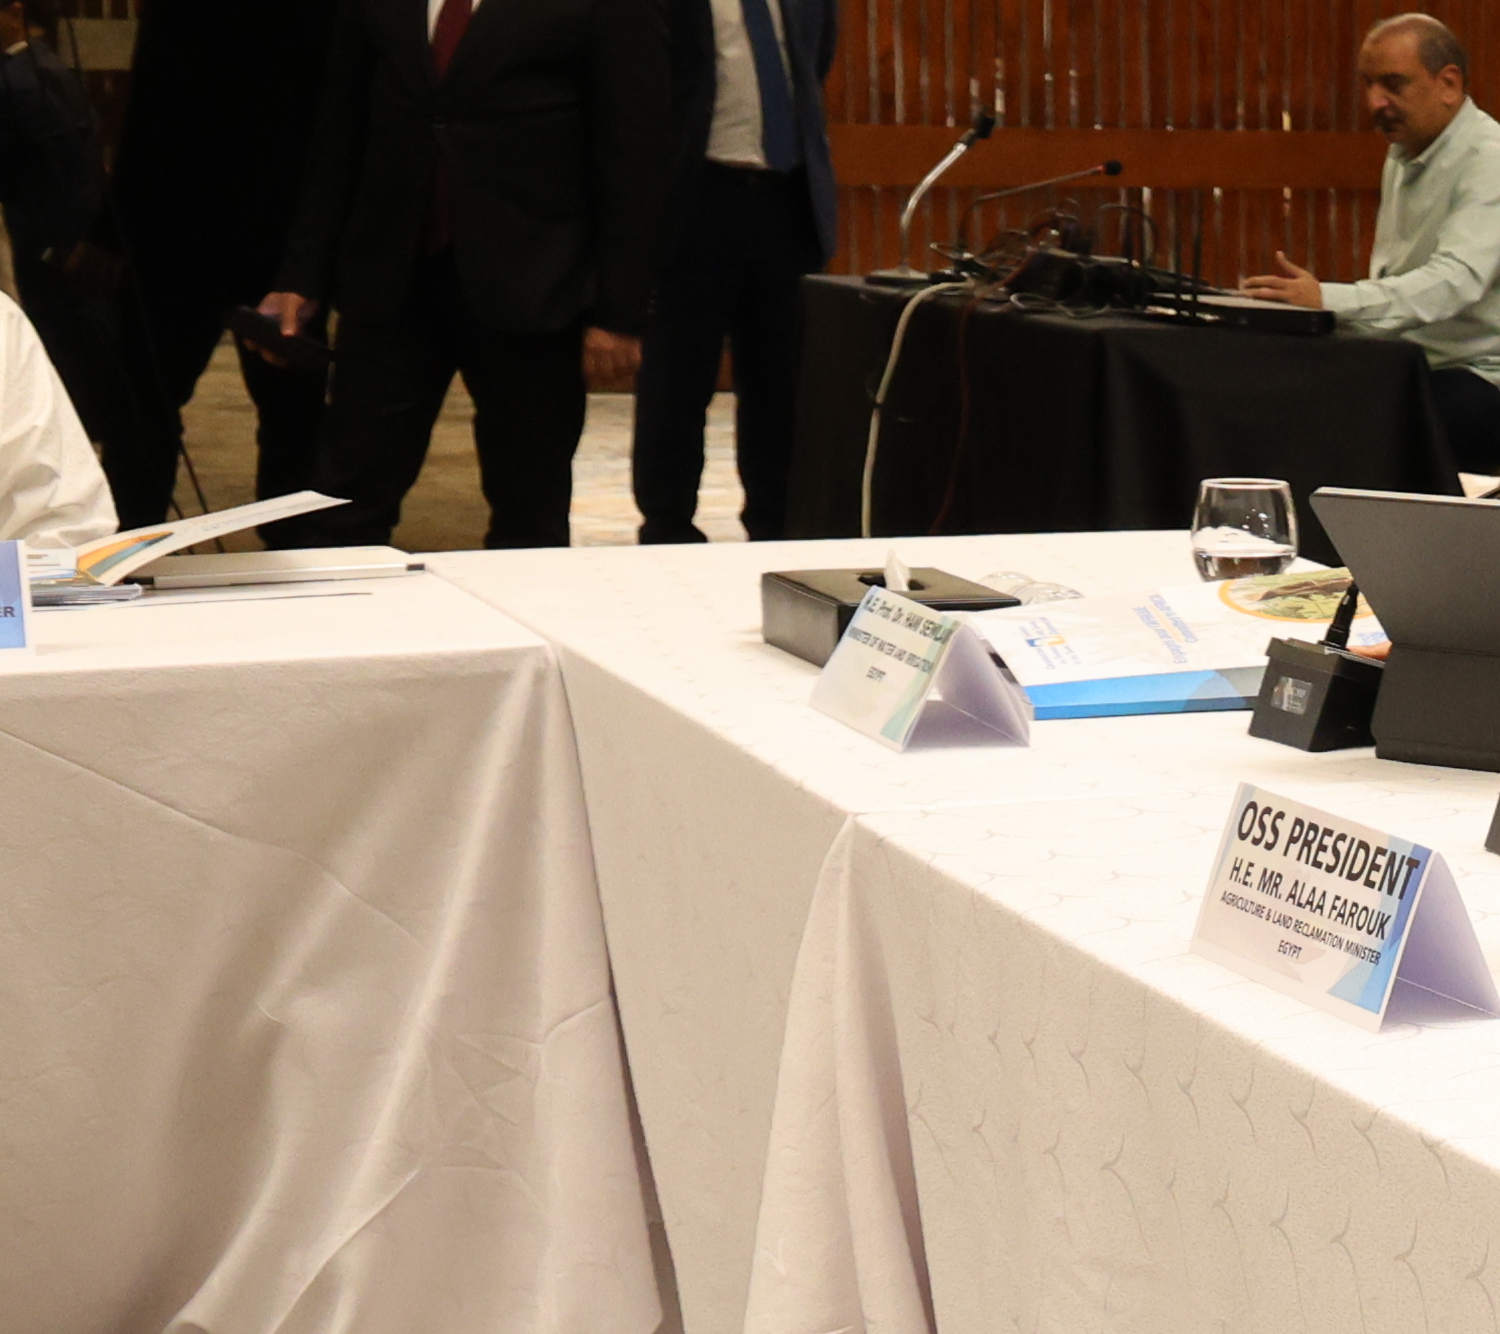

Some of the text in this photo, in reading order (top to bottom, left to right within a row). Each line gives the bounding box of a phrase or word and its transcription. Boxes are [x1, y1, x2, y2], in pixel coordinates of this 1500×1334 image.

[1237, 801, 1421, 900] OSS PRESIDENT
[1220, 891, 1381, 965] AGRICULTURE & LAND RECLAMATION MINISTER
[1229, 857, 1392, 940] H.E. MR. ALAA FAROUK
[1278, 940, 1302, 958] EGYPT
